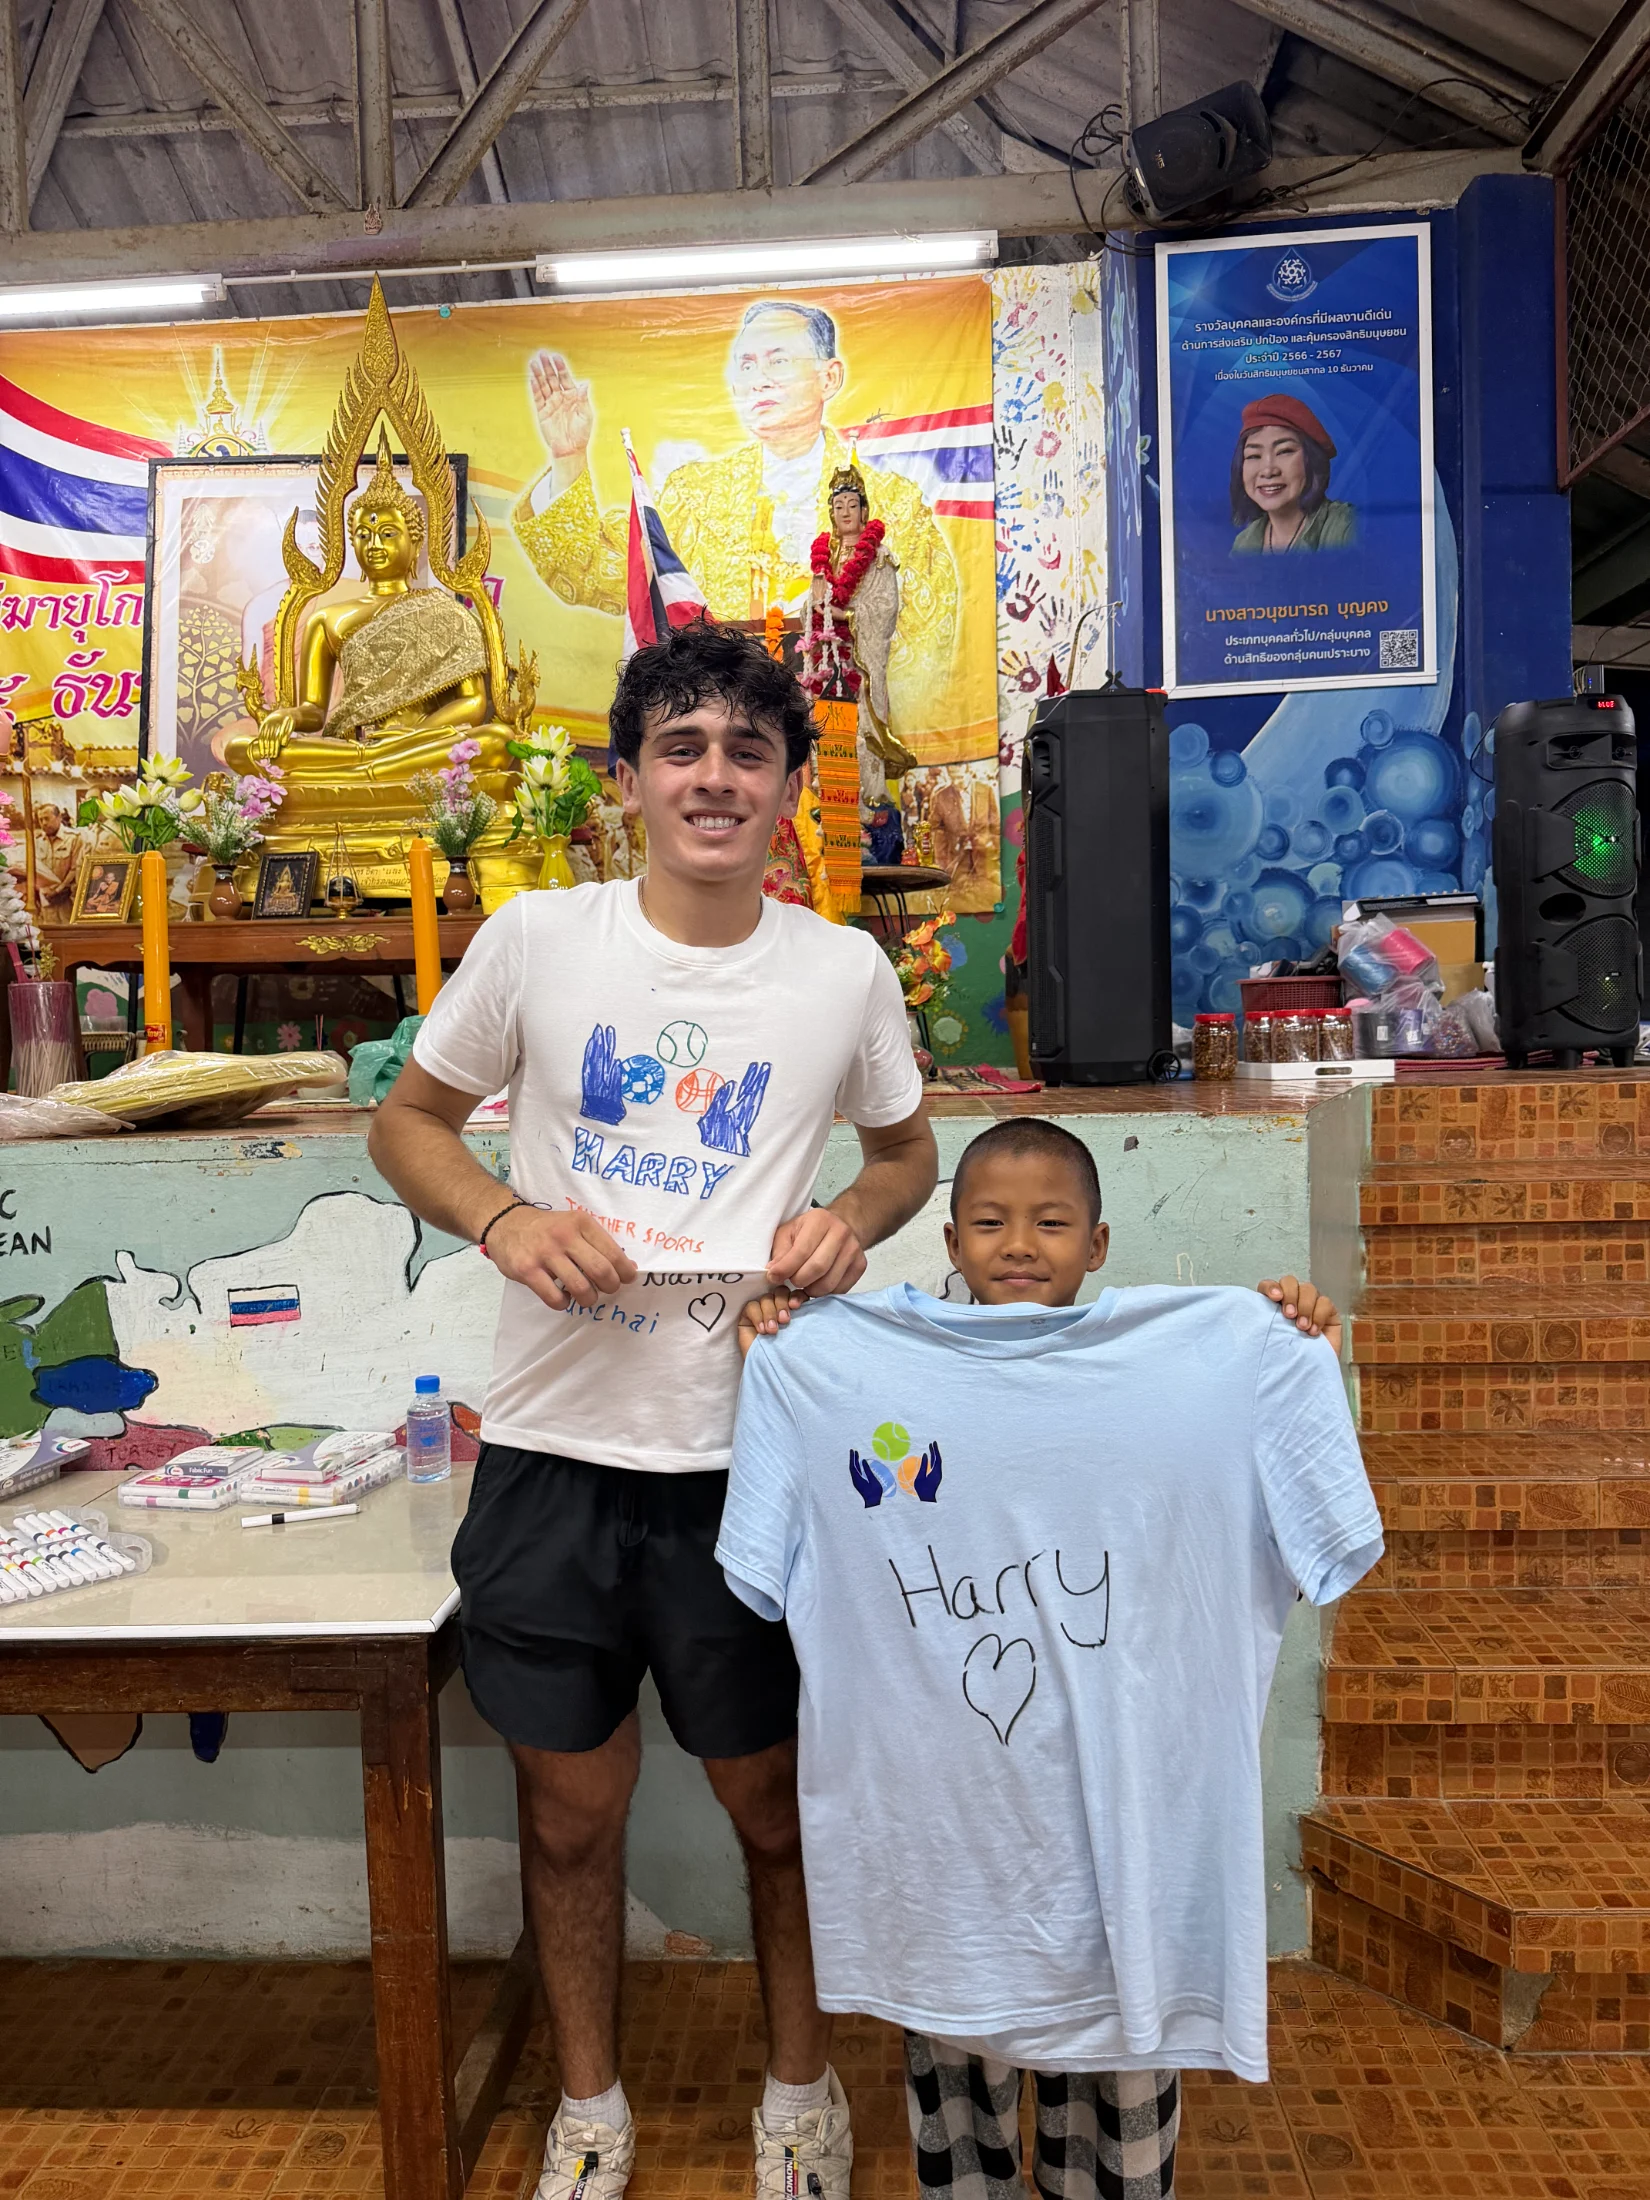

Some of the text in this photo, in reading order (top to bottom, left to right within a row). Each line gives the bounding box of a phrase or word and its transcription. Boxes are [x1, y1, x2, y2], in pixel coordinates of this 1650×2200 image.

[1195, 308, 1392, 332] รางวัลบุคคลและองค์กรที่มีผลงานดีเด่น
[1181, 327, 1407, 351] ด้านการส่งเสริม ปกป้อง และคุ้มครองสิทธิมนุษยชน
[1245, 351, 1280, 364] ประจำปี
[1282, 351, 1308, 361] 2566
[1316, 349, 1342, 359] 2567
[1327, 365, 1339, 374] 10
[1340, 363, 1374, 373] ธันวาคม
[0, 570, 143, 644] ฆายุโก
[1205, 599, 1389, 624] นางสาวนุชนารถ บุญคง
[1225, 628, 1372, 647] ประเภทบุคคลทั่วไป/กลุ่มบุคคล
[1224, 647, 1371, 666] ด้านสิทธิของกลุ่มคนเปราะบาง
[53, 650, 142, 718] ธัน
[571, 1127, 735, 1200] HARRY
[642, 1227, 704, 1254] SPORTS
[888, 1544, 1110, 1649] Harry
